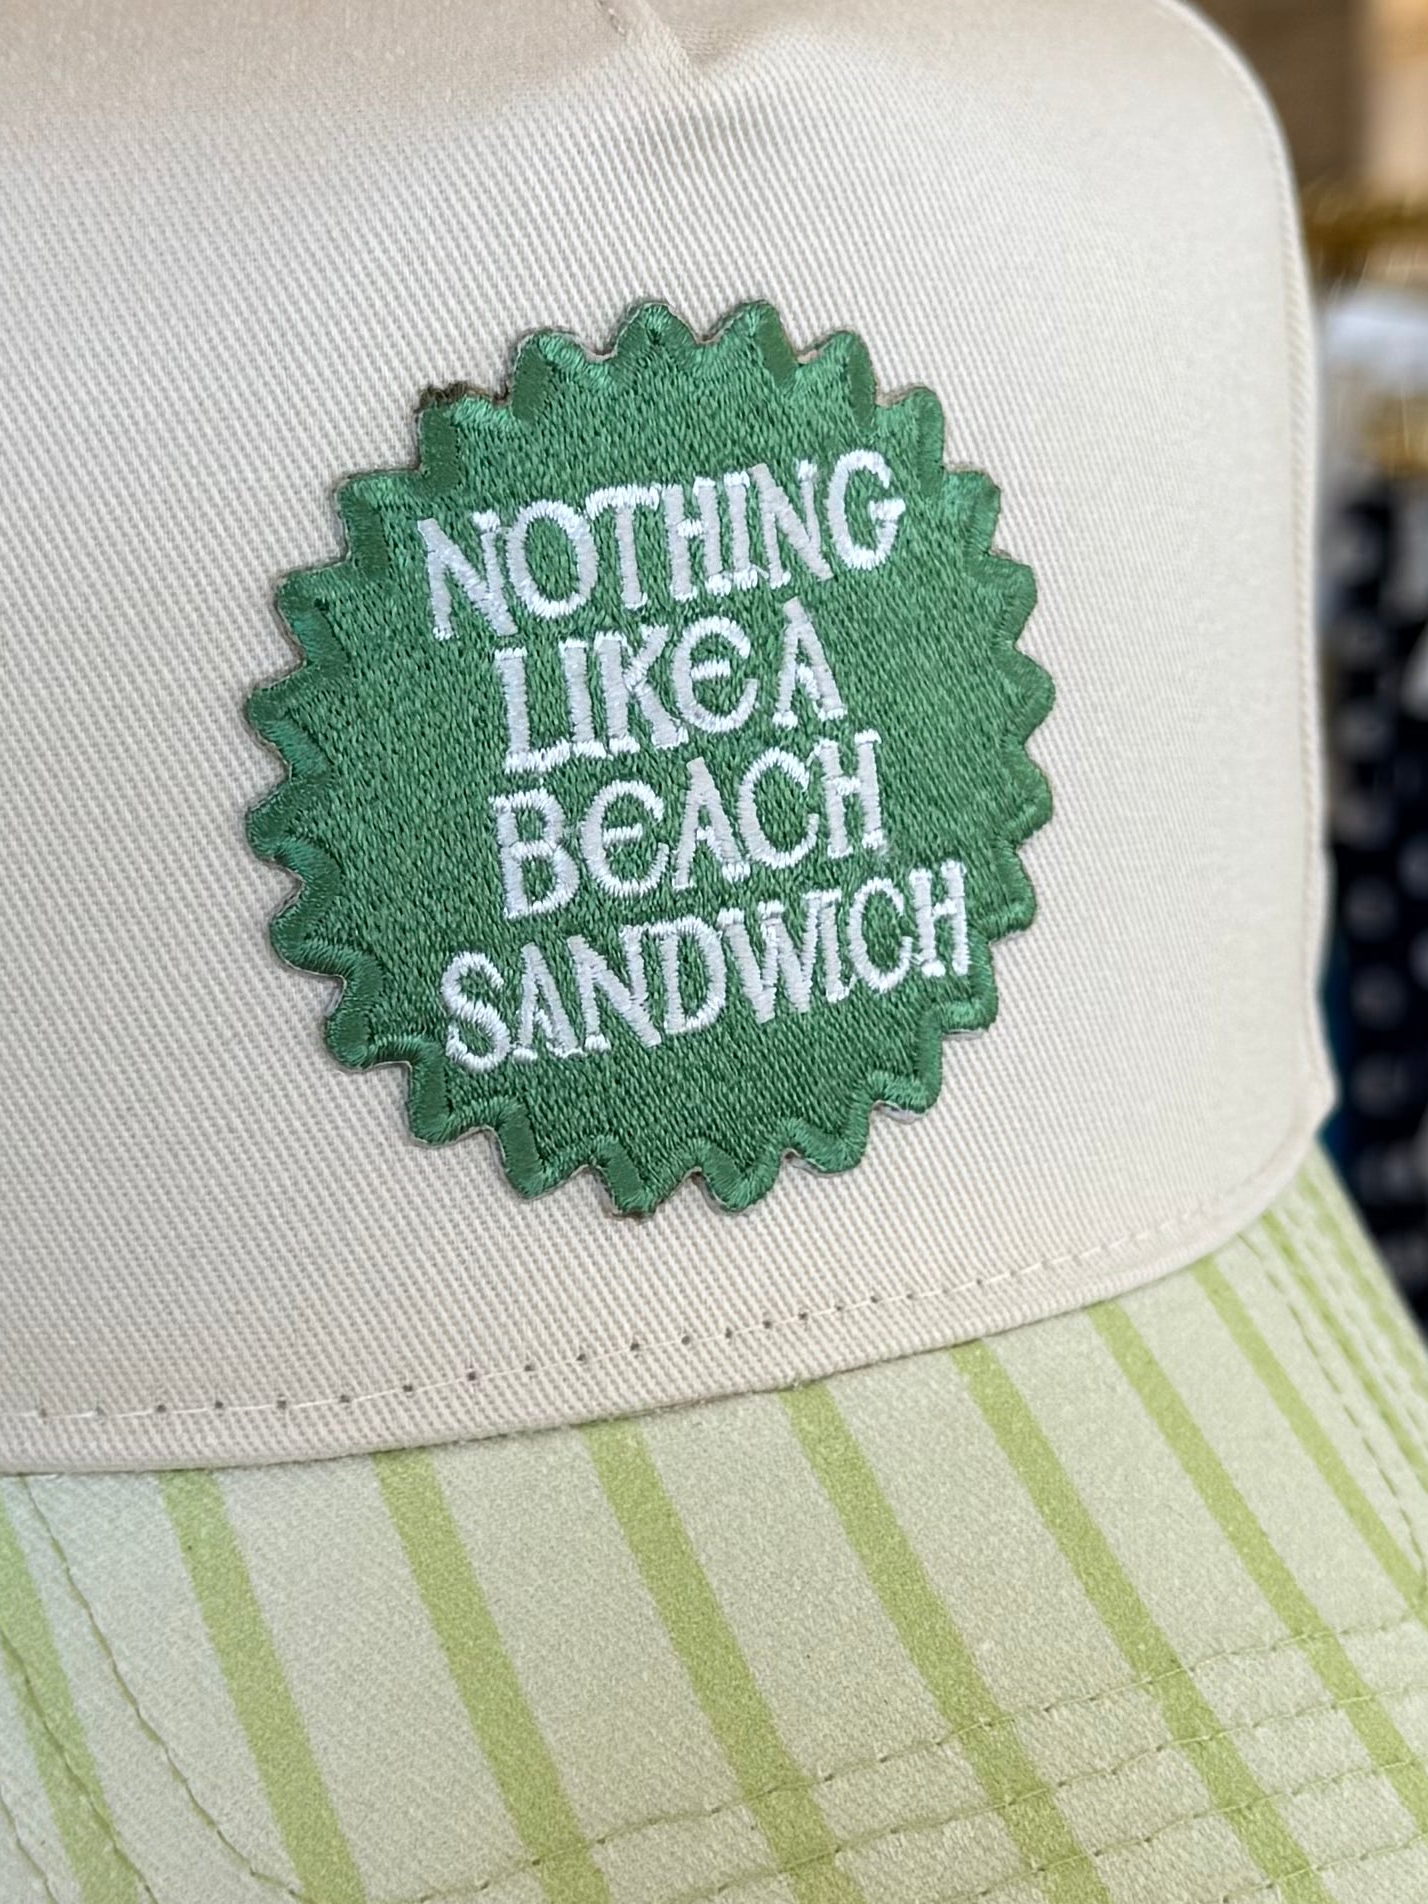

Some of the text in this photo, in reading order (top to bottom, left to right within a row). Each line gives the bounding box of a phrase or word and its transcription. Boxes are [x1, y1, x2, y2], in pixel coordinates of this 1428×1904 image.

[416, 450, 906, 639] NOTHING
[494, 596, 845, 774] LIKE A
[489, 729, 888, 920] BEACH
[439, 859, 973, 1073] SANDWICH
